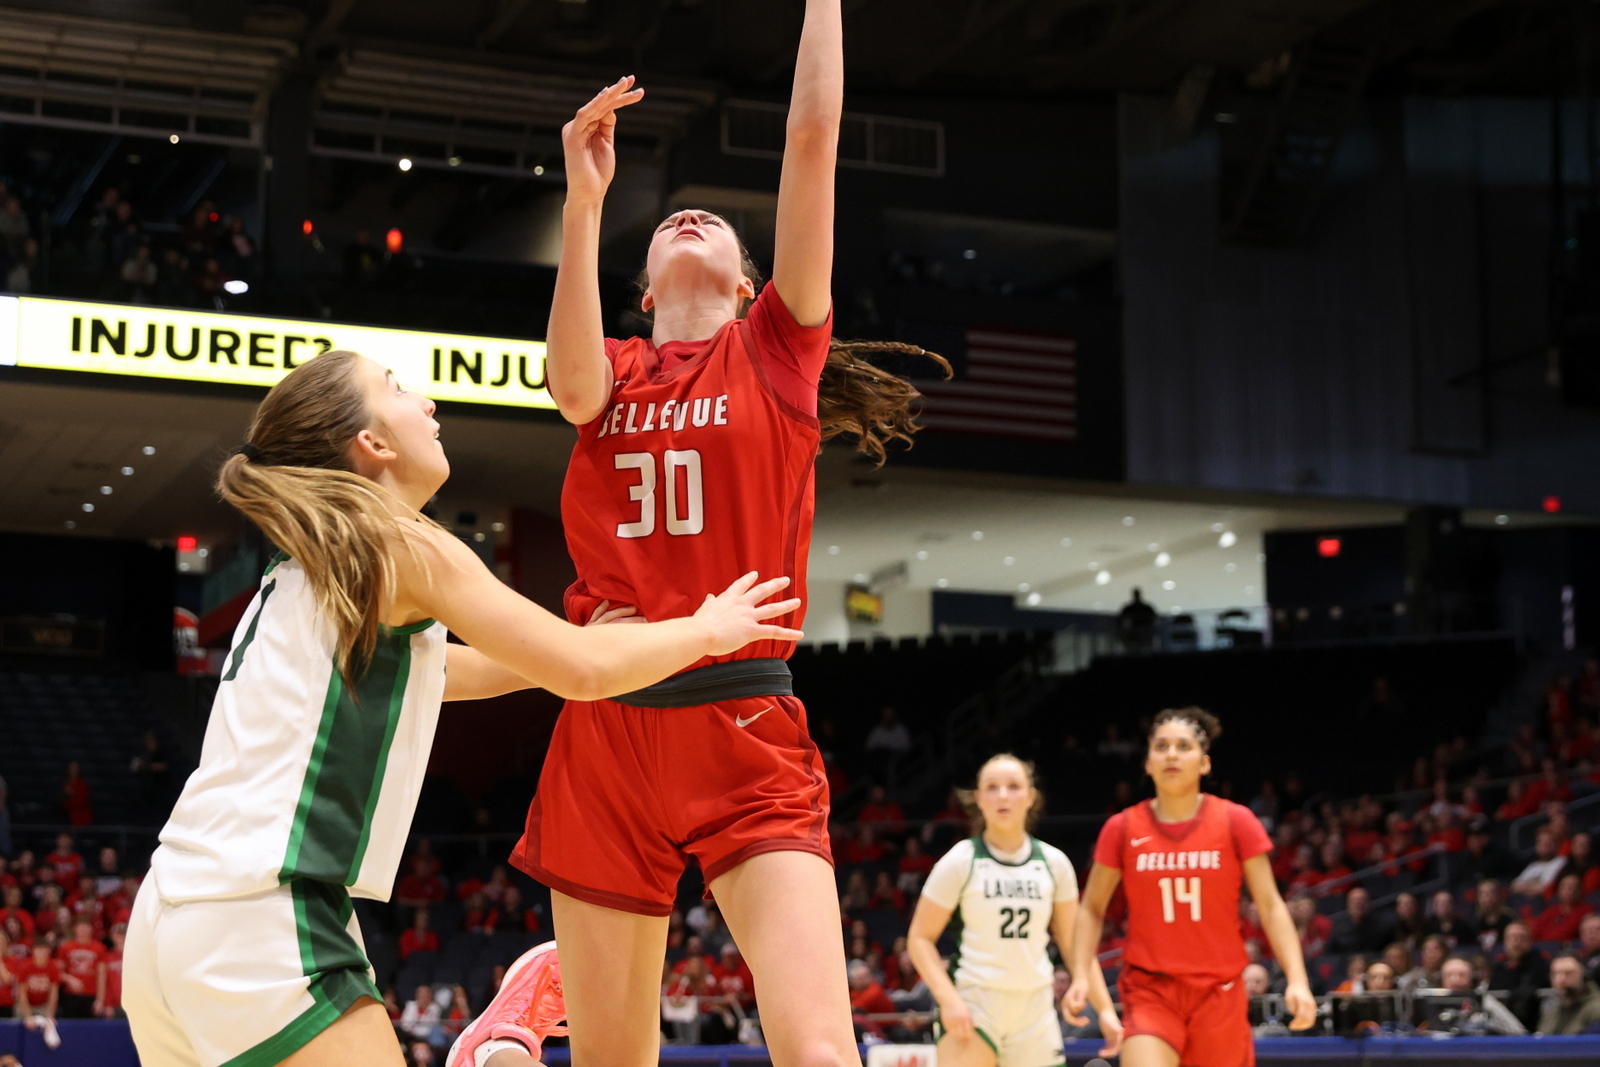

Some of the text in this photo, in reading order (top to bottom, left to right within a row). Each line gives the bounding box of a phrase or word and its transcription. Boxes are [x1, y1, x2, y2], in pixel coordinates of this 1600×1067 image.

[614, 449, 704, 538] 30
[1136, 850, 1221, 872] BELLEVUE
[983, 878, 1043, 900] LAUREL
[1157, 876, 1202, 924] 14
[1000, 907, 1031, 939] 22
